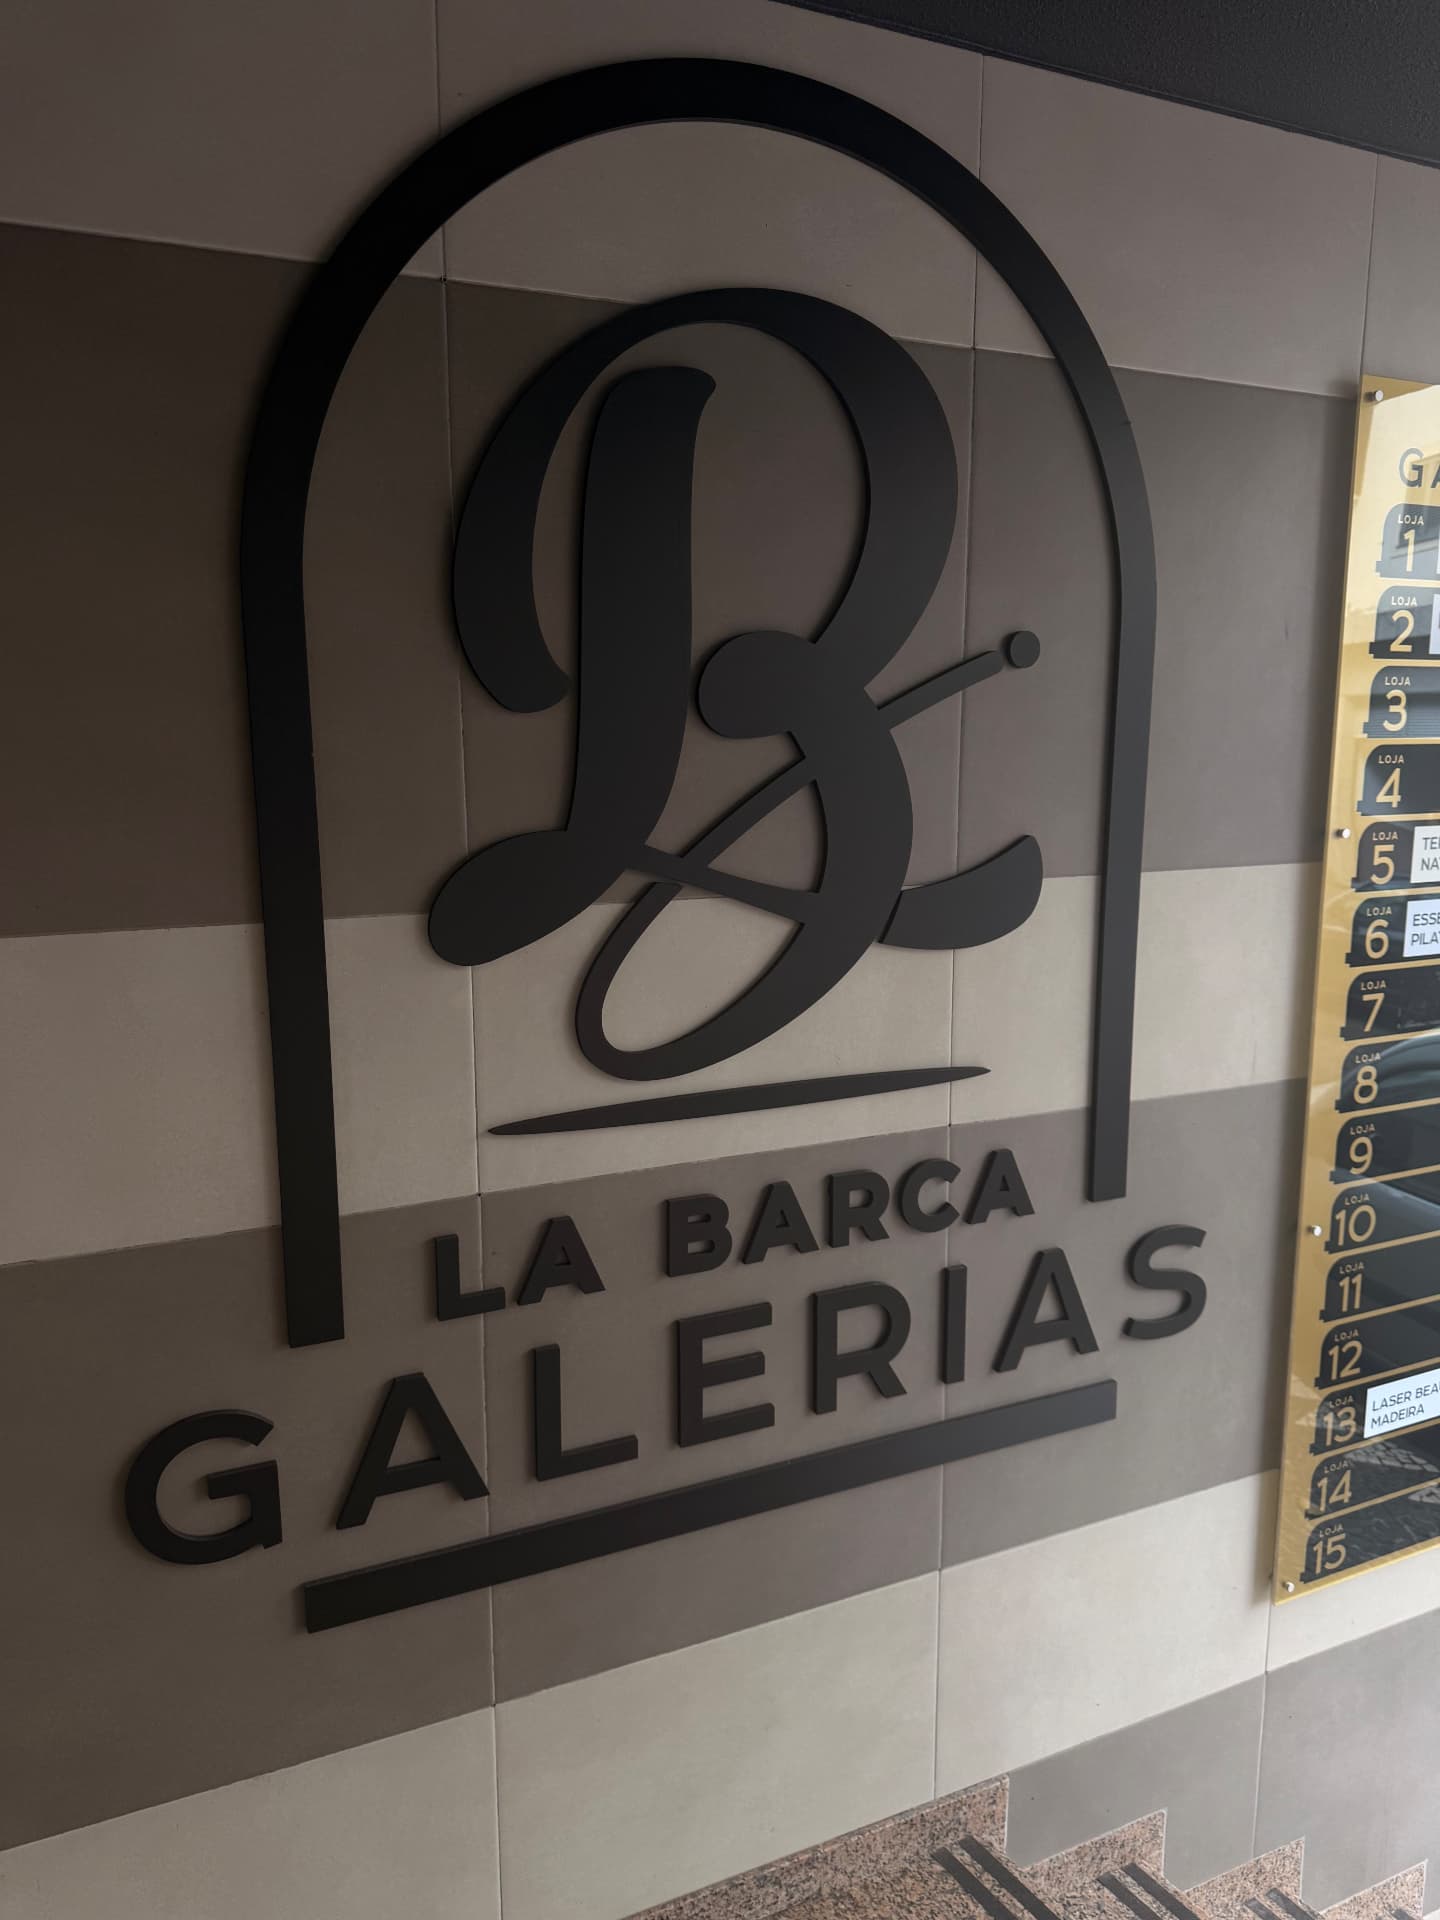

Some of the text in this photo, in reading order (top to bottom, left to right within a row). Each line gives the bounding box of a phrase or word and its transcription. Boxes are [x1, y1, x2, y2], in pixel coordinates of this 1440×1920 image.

[1398, 513, 1424, 525] LOJA
[1403, 529, 1416, 572] 1
[1391, 596, 1418, 606] LOJA
[1389, 609, 1415, 652] 2
[1384, 676, 1411, 686] LOJA
[1382, 689, 1408, 732] 3
[1378, 754, 1405, 764] LOJA
[1375, 767, 1402, 809] 4
[1372, 831, 1399, 841] LOJA
[1422, 836, 1440, 850] TE
[1370, 844, 1395, 885] 5
[1421, 857, 1440, 871] NA
[1366, 906, 1392, 917] LOJA
[1365, 918, 1389, 960] 6
[1411, 930, 1440, 946] PILA
[1360, 980, 1387, 991] LOJA
[1362, 992, 1385, 1032] 7
[1355, 1052, 1381, 1064] LOJA
[1353, 1065, 1378, 1104] 8
[1350, 1123, 1376, 1135] LOJA
[1349, 1136, 1373, 1175] 9
[1344, 1193, 1370, 1206] LOJA
[434, 1148, 1035, 1321] LA BARCA
[1335, 1204, 1377, 1246] 10
[1339, 1262, 1365, 1274] LOJA
[1339, 1273, 1363, 1313] 11
[1334, 1329, 1359, 1342] LOJA
[1328, 1340, 1363, 1381] 12
[125, 1223, 1208, 1565] GALERIAS
[1329, 1395, 1354, 1408] LOJA
[1372, 1382, 1440, 1412] LASER BEA
[1323, 1406, 1357, 1446] 13
[1371, 1403, 1425, 1429] MADEIRA
[1324, 1460, 1349, 1474] LOJA
[1317, 1469, 1352, 1512] 14
[1319, 1523, 1344, 1538] LOJA
[1313, 1533, 1347, 1575] 15
